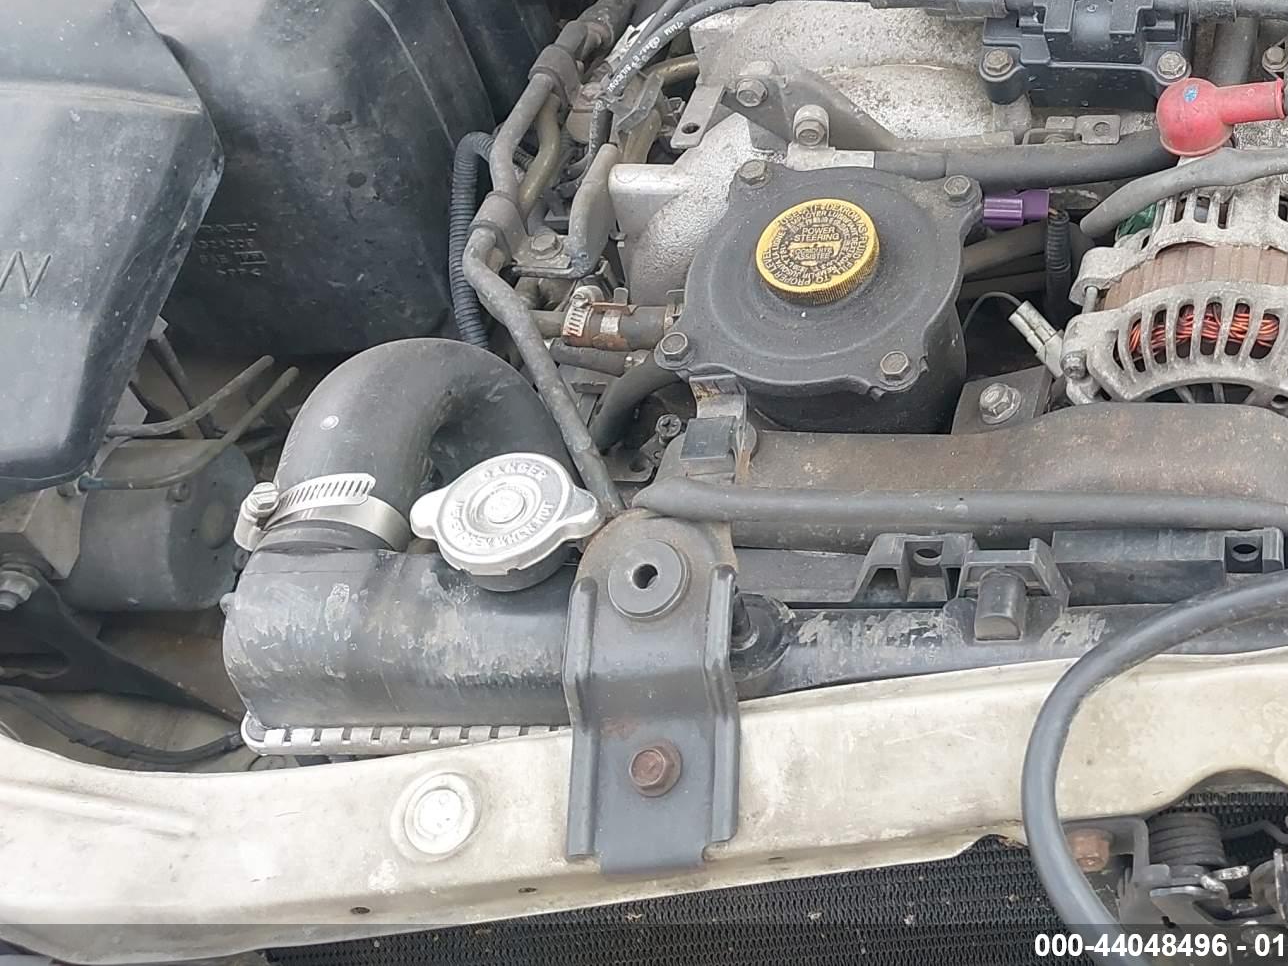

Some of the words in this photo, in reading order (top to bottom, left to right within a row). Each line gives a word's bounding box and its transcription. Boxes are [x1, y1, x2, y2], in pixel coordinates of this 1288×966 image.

[793, 233, 839, 242] STEERING
[802, 226, 835, 235] POWER
[851, 234, 867, 260] FLUID
[762, 248, 776, 273] LEVEL
[770, 269, 810, 286] PROPER
[482, 462, 548, 482] DANGER
